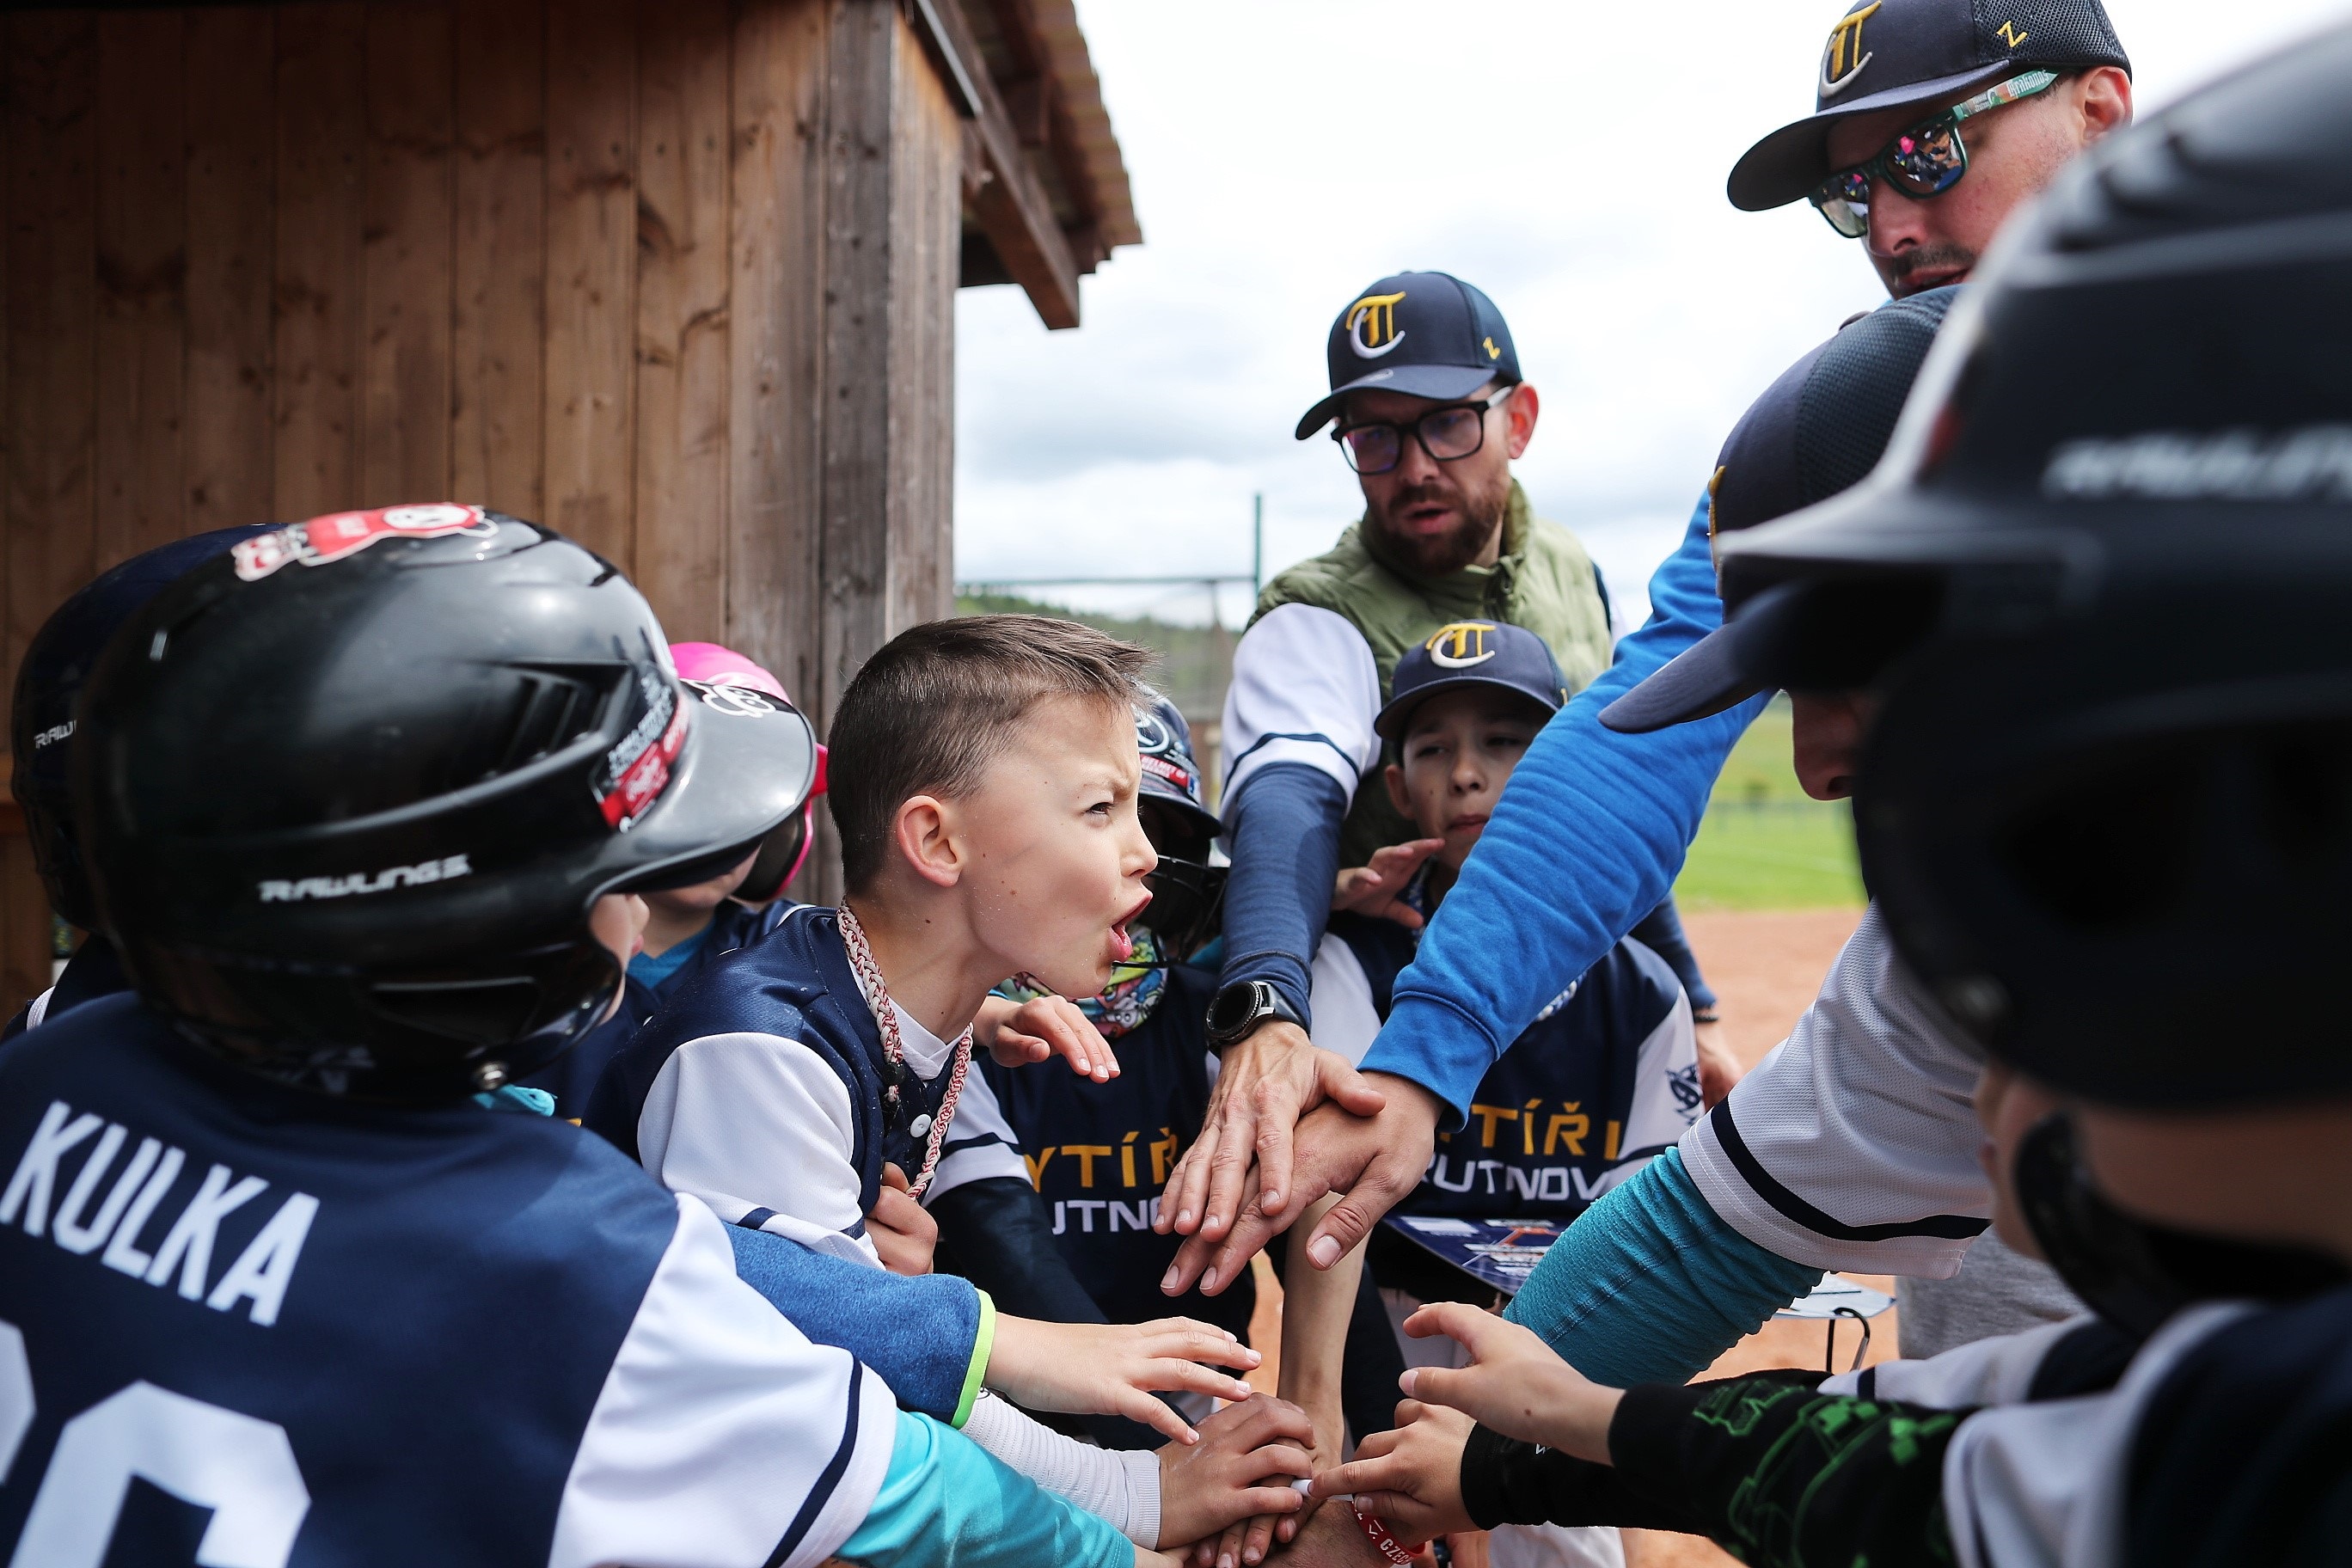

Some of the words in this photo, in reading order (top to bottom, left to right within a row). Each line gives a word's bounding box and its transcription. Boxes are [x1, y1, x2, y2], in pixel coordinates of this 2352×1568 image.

[34, 719, 77, 749] RAW
[257, 853, 472, 902] RAWLINGS
[1439, 1098, 1621, 1161] TÍŘI
[0, 1099, 321, 1327] KULKA
